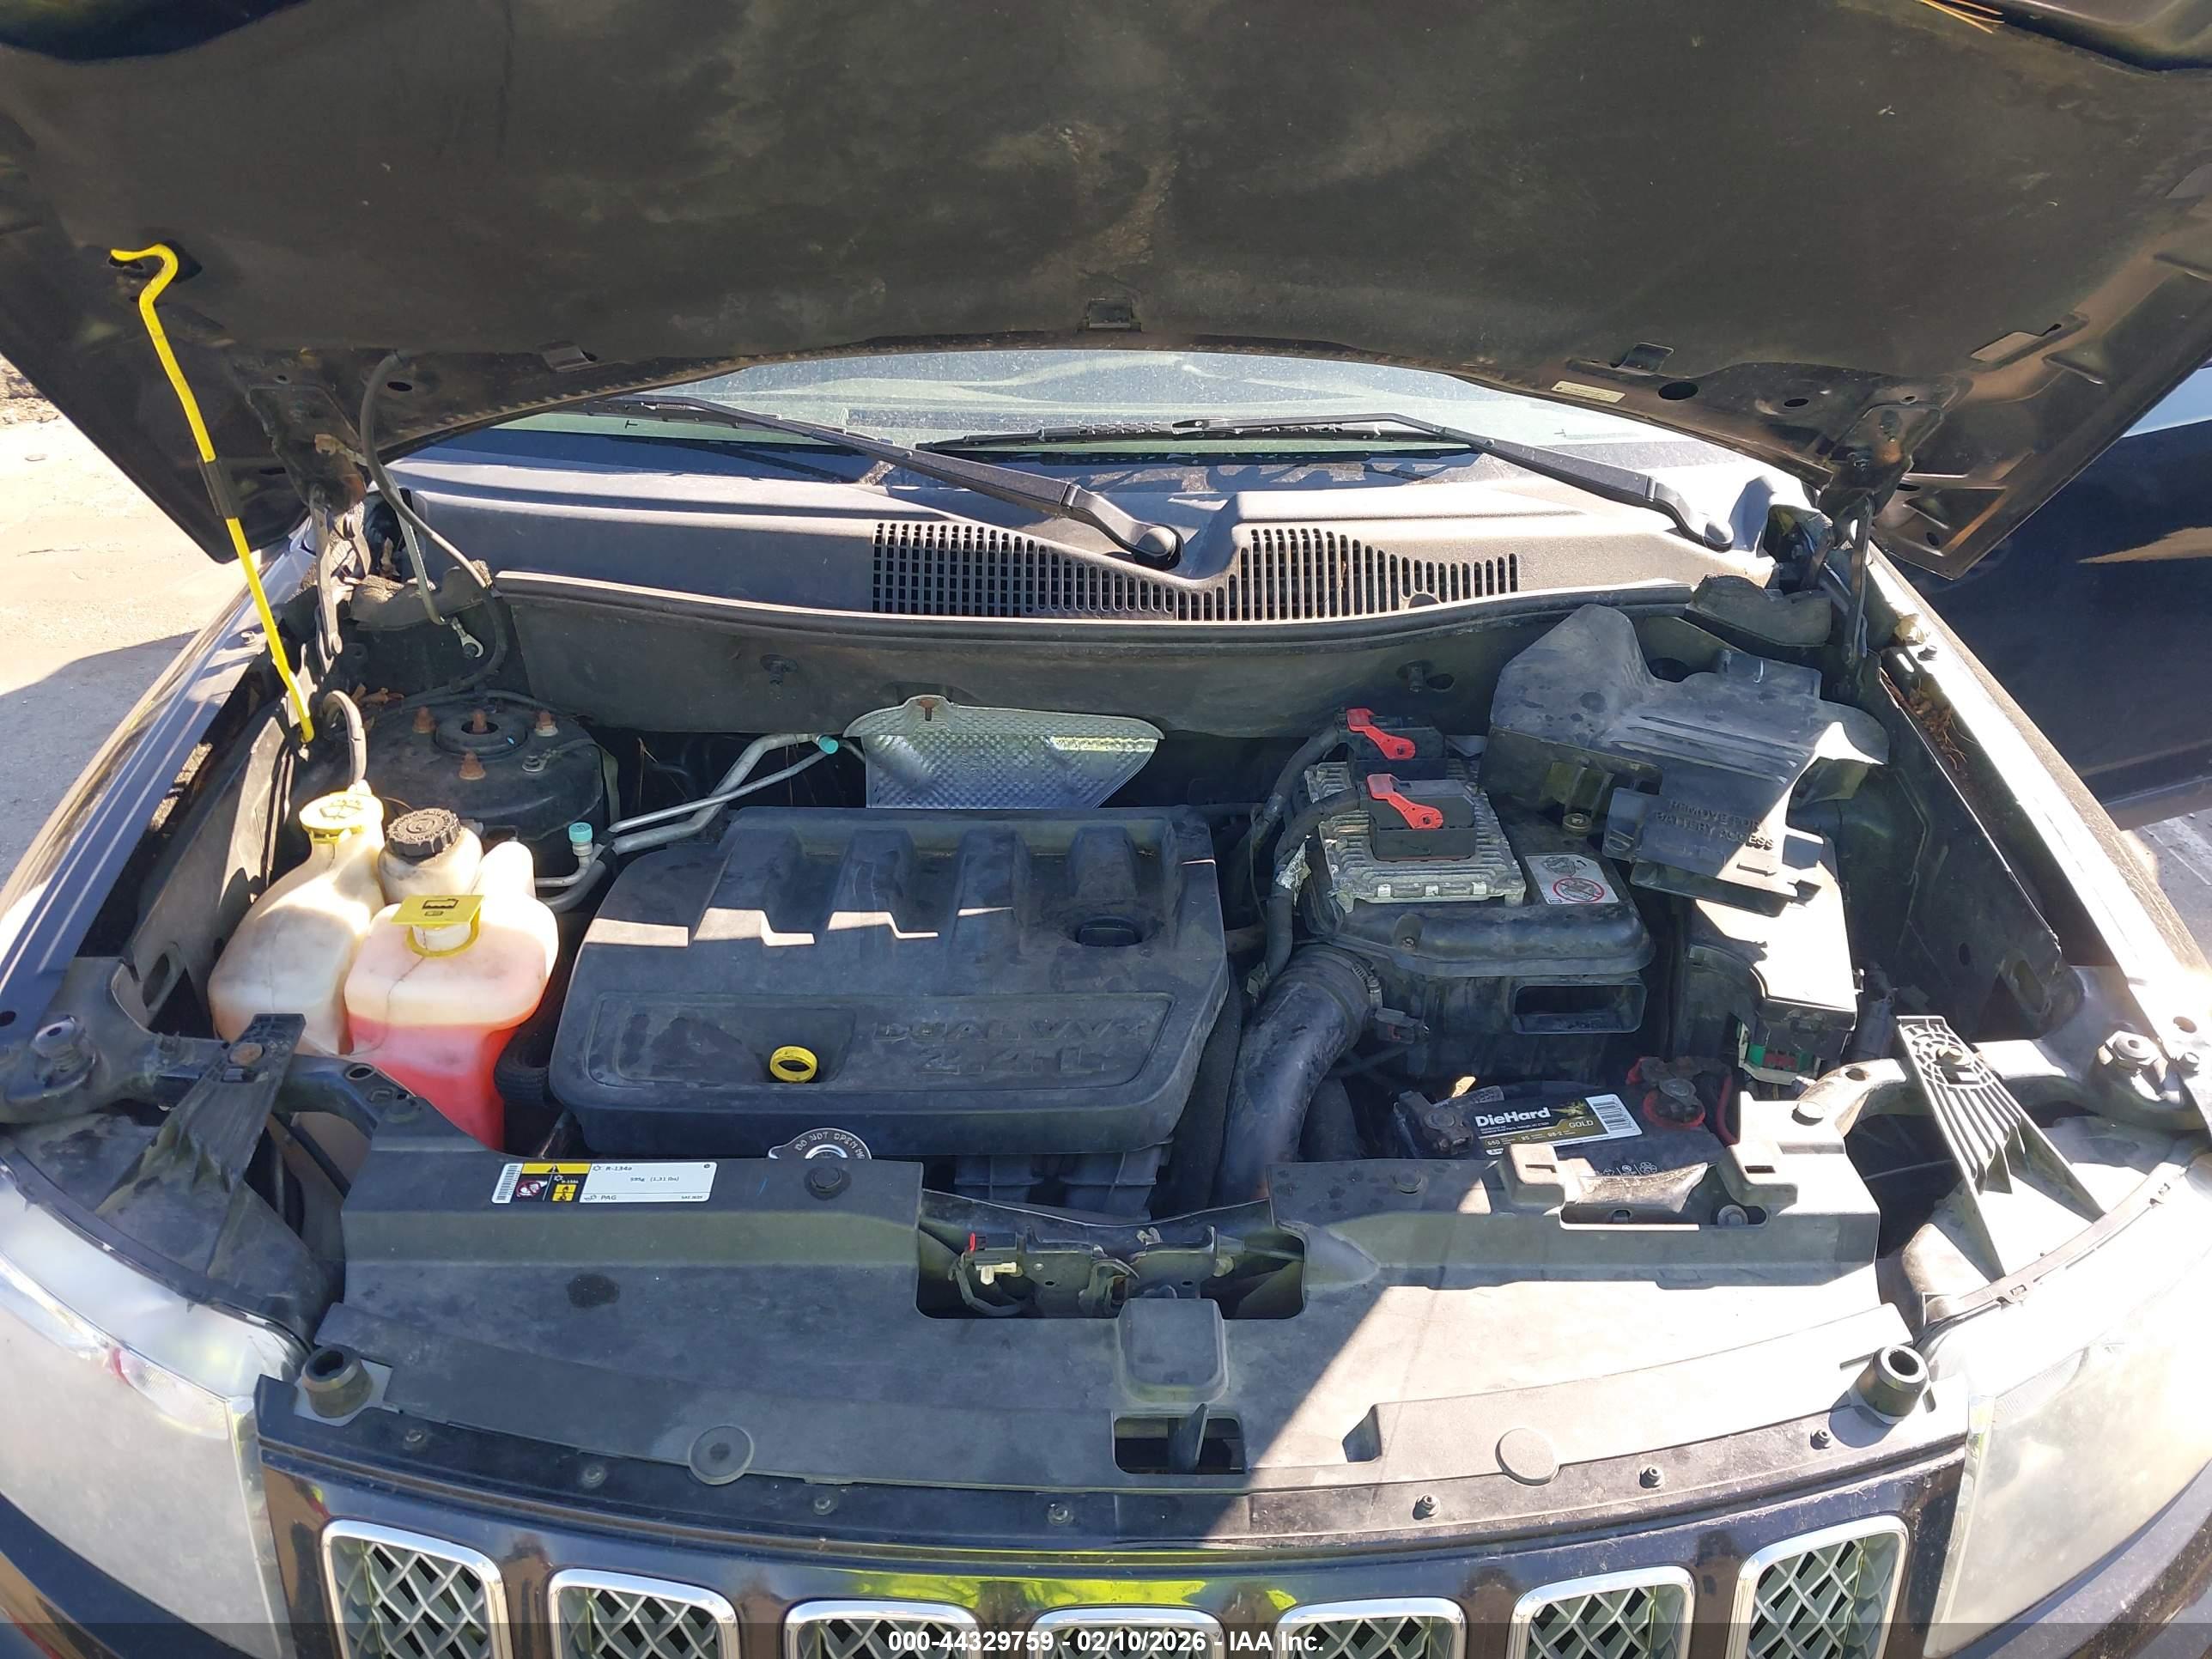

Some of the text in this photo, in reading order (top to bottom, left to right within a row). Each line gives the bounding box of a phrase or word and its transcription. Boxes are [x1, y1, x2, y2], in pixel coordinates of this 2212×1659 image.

[1669, 799, 1760, 832] REMOVE FOR
[1655, 811, 1774, 850] BATTERY ACCESS
[919, 1047, 1106, 1075] 2.4L
[1475, 1107, 1551, 1127] DieHard
[1569, 1120, 1594, 1128] GOLD
[795, 1139, 808, 1152] DO
[809, 1132, 829, 1141] NOT
[834, 1133, 859, 1149] OPEN
